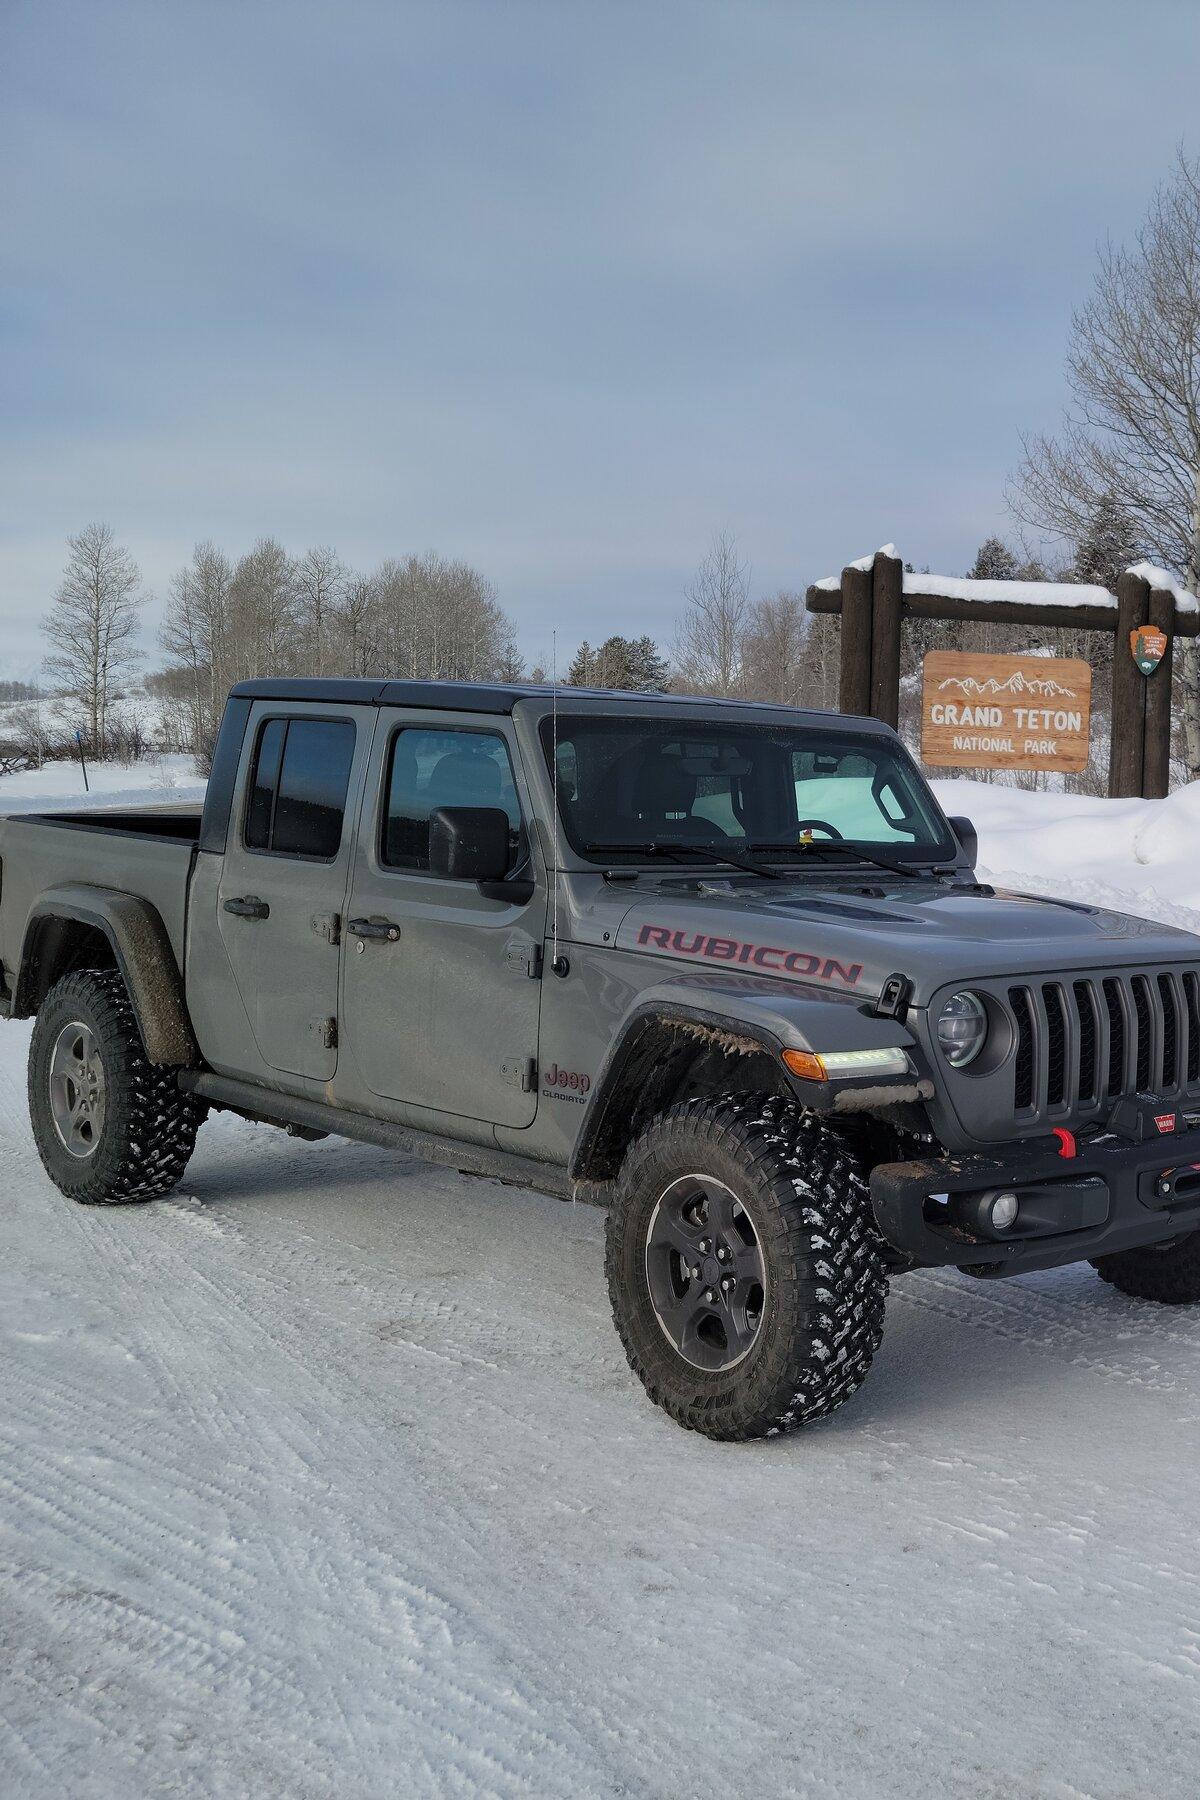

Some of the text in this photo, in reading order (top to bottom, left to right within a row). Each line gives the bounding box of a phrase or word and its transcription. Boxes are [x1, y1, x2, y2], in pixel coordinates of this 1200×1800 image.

[931, 704, 1082, 732] GRAND TETON
[953, 736, 1058, 755] NATIONAL PARK
[637, 925, 865, 985] RUBICON
[544, 1063, 591, 1096] Jeep
[542, 1089, 588, 1105] GLADIATO
